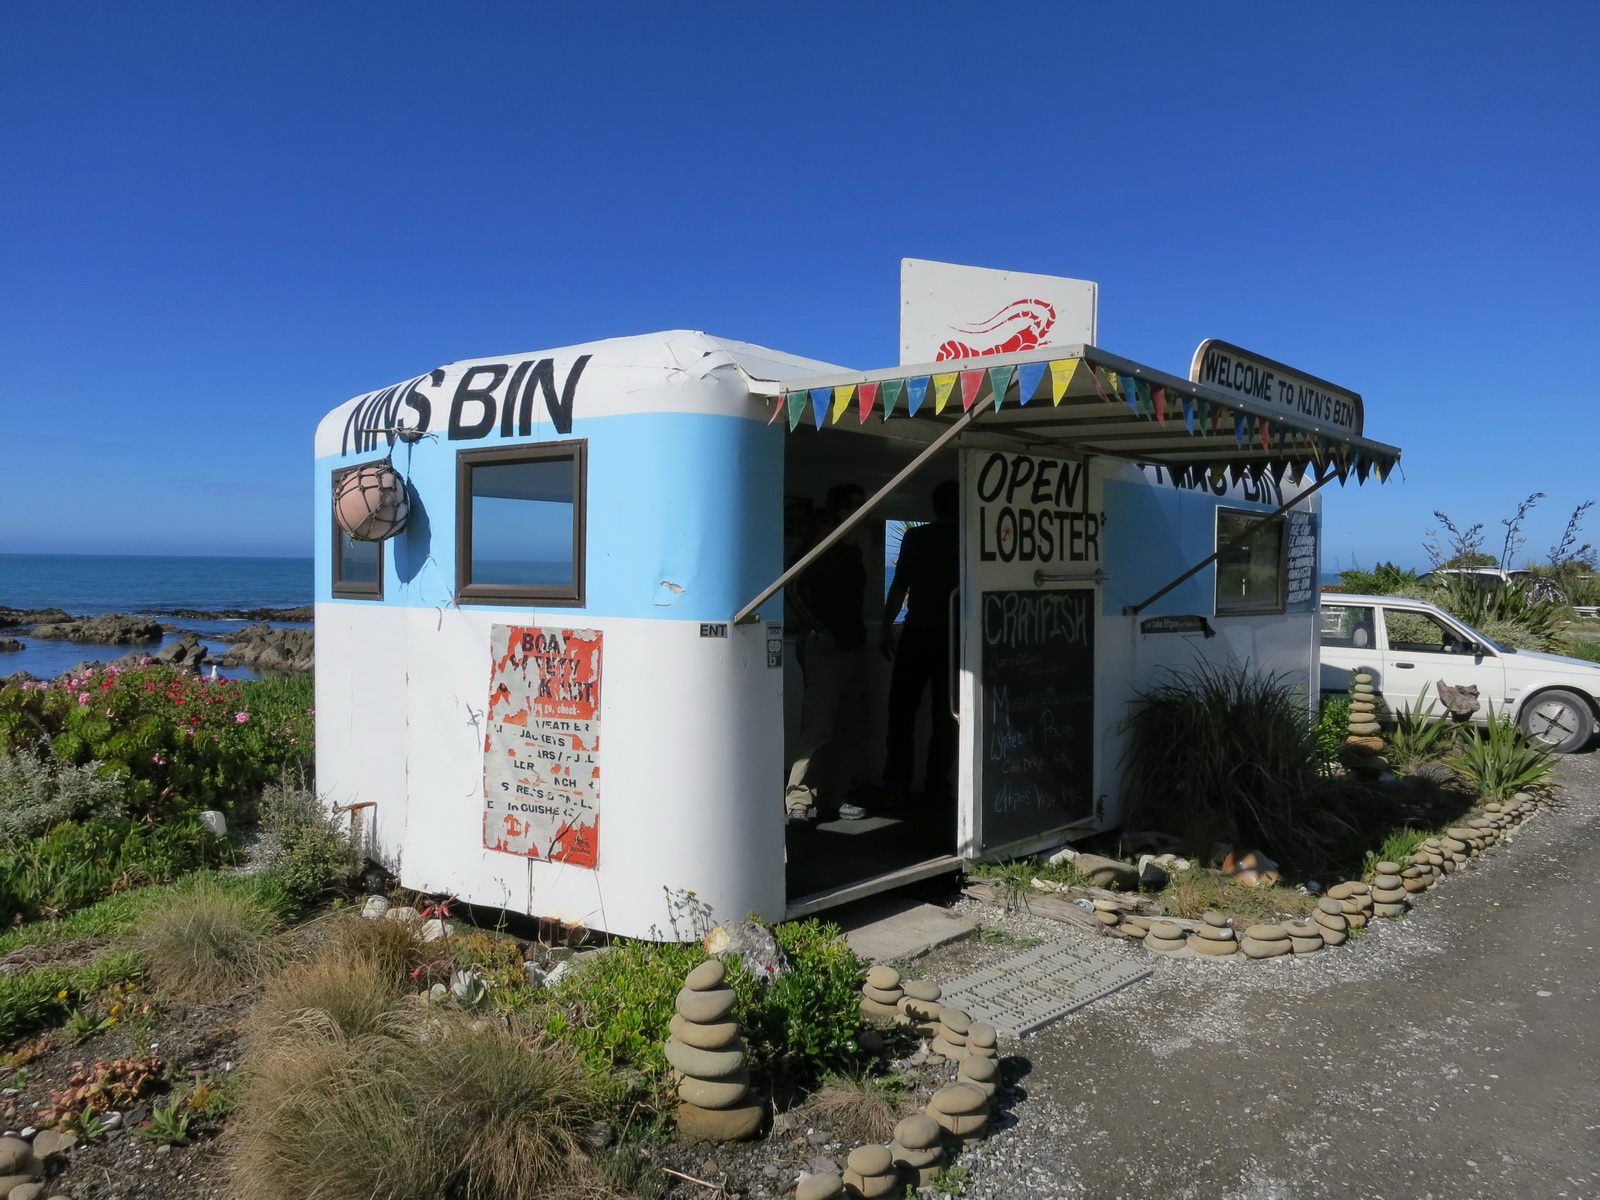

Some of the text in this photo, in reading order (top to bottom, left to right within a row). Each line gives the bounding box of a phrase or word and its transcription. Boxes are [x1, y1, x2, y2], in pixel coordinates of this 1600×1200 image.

[448, 354, 593, 441] BIN
[1206, 352, 1355, 429] WELCOME TO NIN'S BIN
[977, 452, 1083, 508] OPEN
[979, 506, 1100, 563] LOBSTER
[700, 624, 728, 637] ENT
[985, 591, 1088, 649] CRAYFISH
